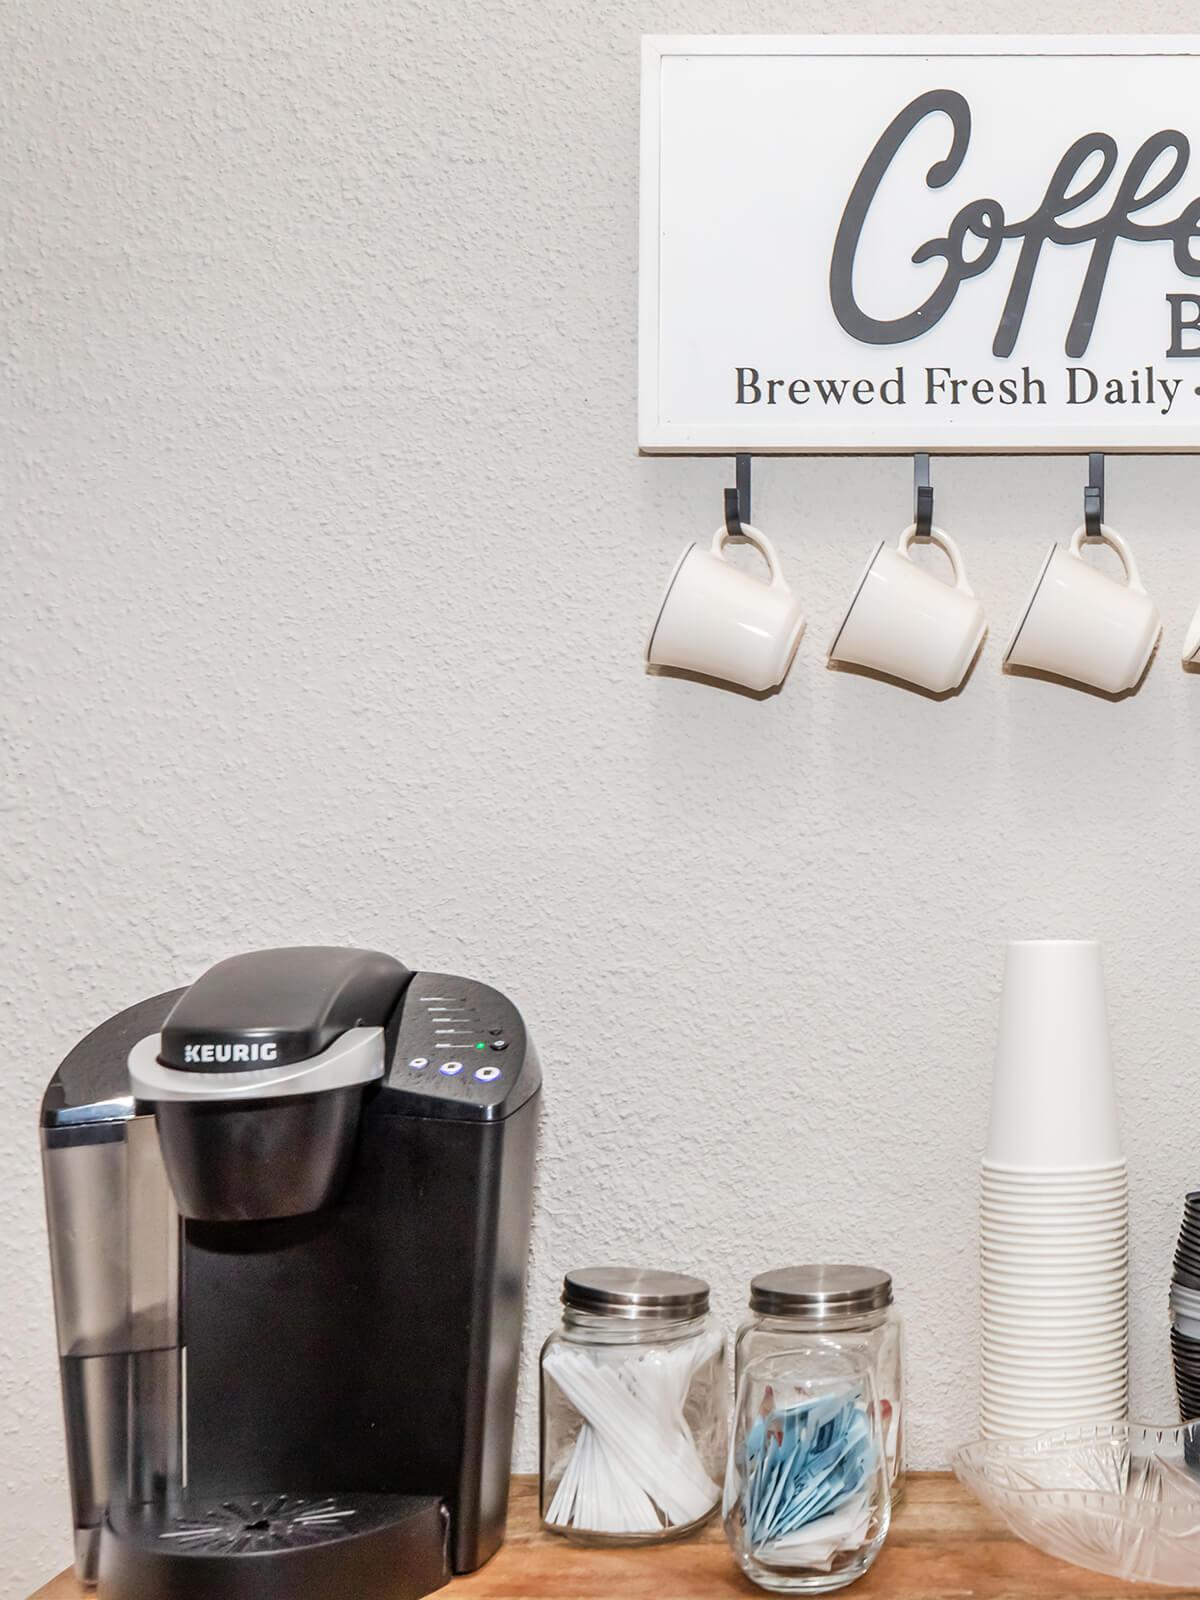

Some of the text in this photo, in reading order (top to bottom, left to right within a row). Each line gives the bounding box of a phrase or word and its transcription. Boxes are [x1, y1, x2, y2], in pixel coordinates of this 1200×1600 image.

[736, 367, 906, 405] Brewed
[925, 367, 1047, 405] Fresh
[1066, 366, 1183, 415] Daily
[184, 1043, 278, 1062] KEURIG
